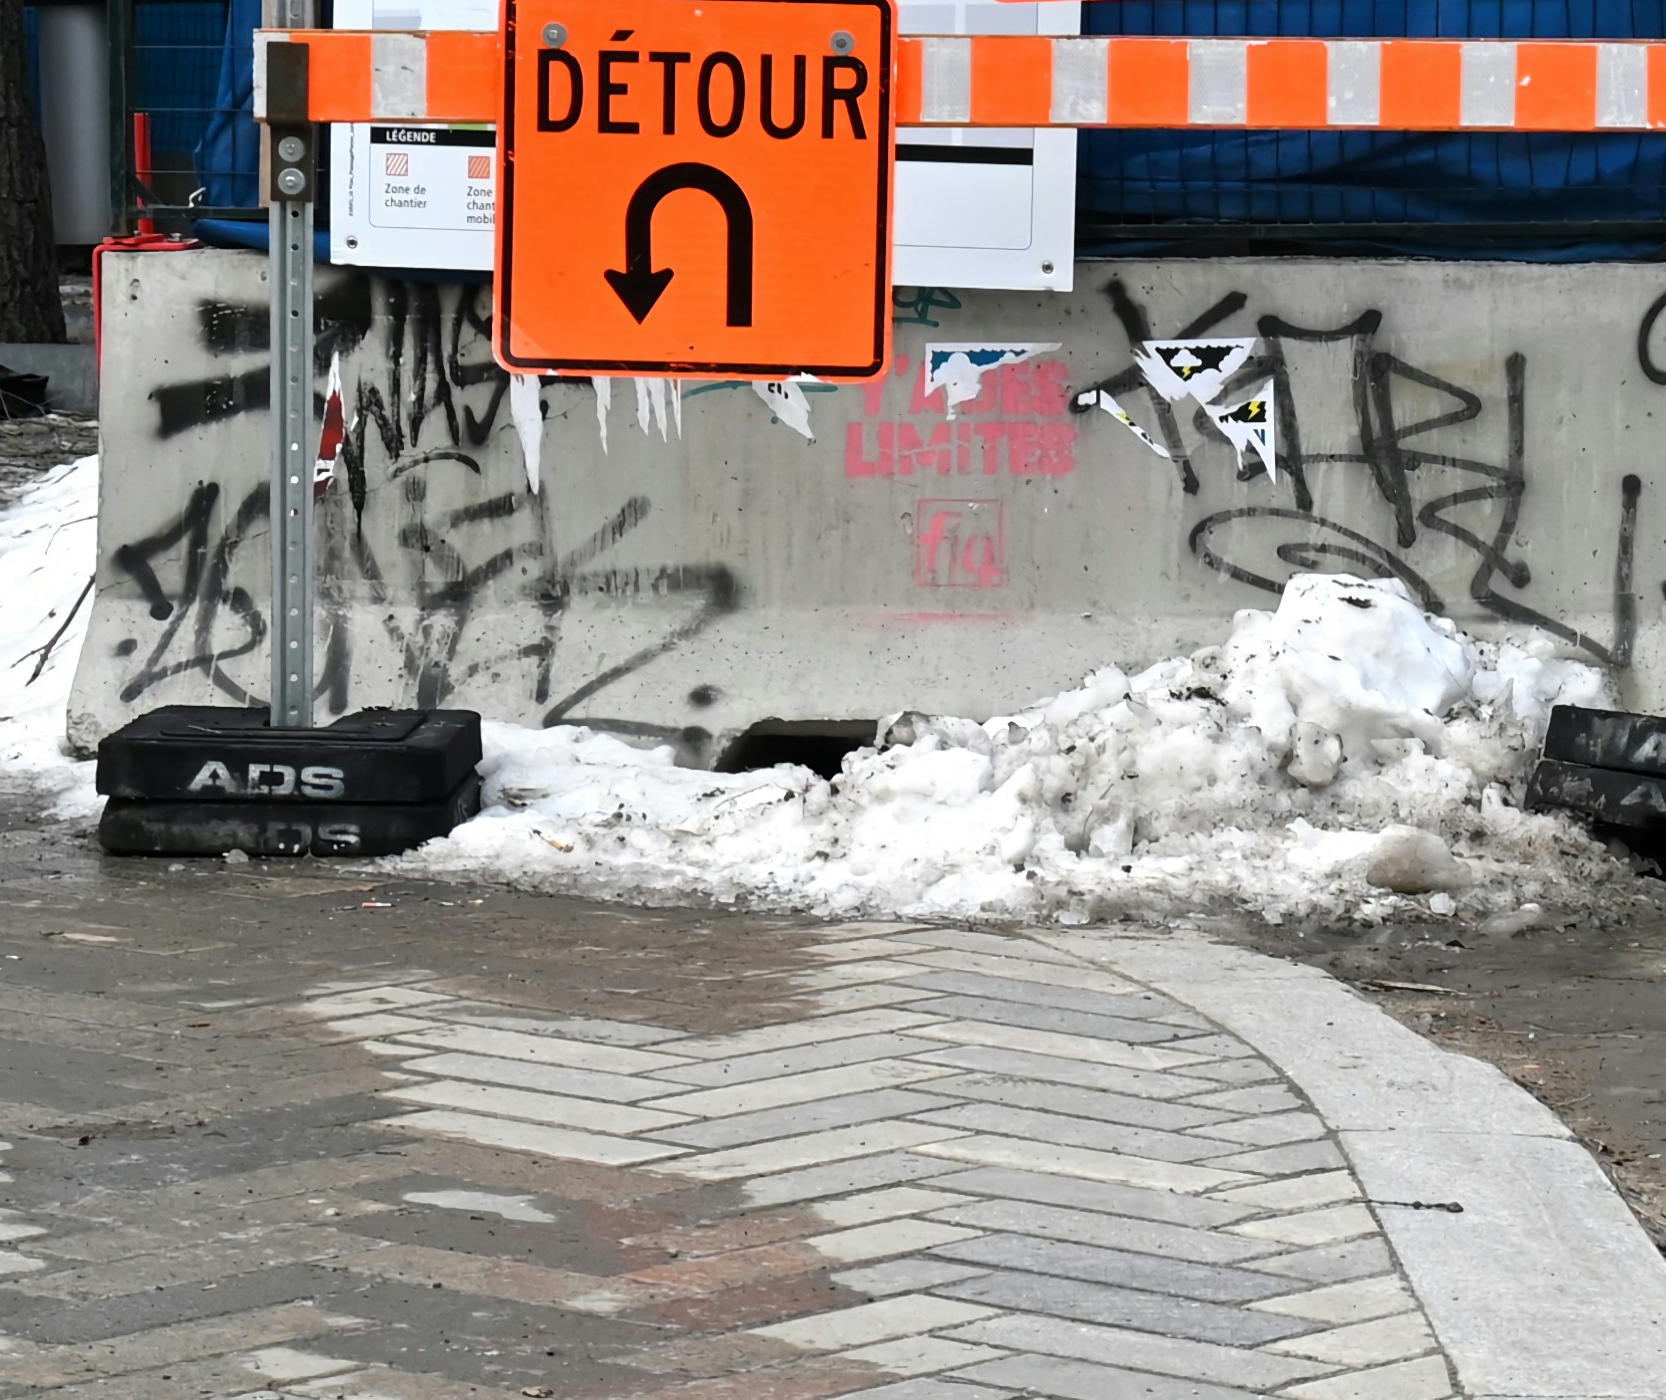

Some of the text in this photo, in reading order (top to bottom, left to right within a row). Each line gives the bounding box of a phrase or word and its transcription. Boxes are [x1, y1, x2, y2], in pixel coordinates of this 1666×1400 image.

[536, 29, 869, 141] DÉTOUR
[385, 128, 437, 143] LÉGENDE
[384, 183, 427, 195] Zone de
[466, 186, 493, 197] Zone
[384, 197, 428, 209] chantier
[186, 760, 346, 799] ADS
